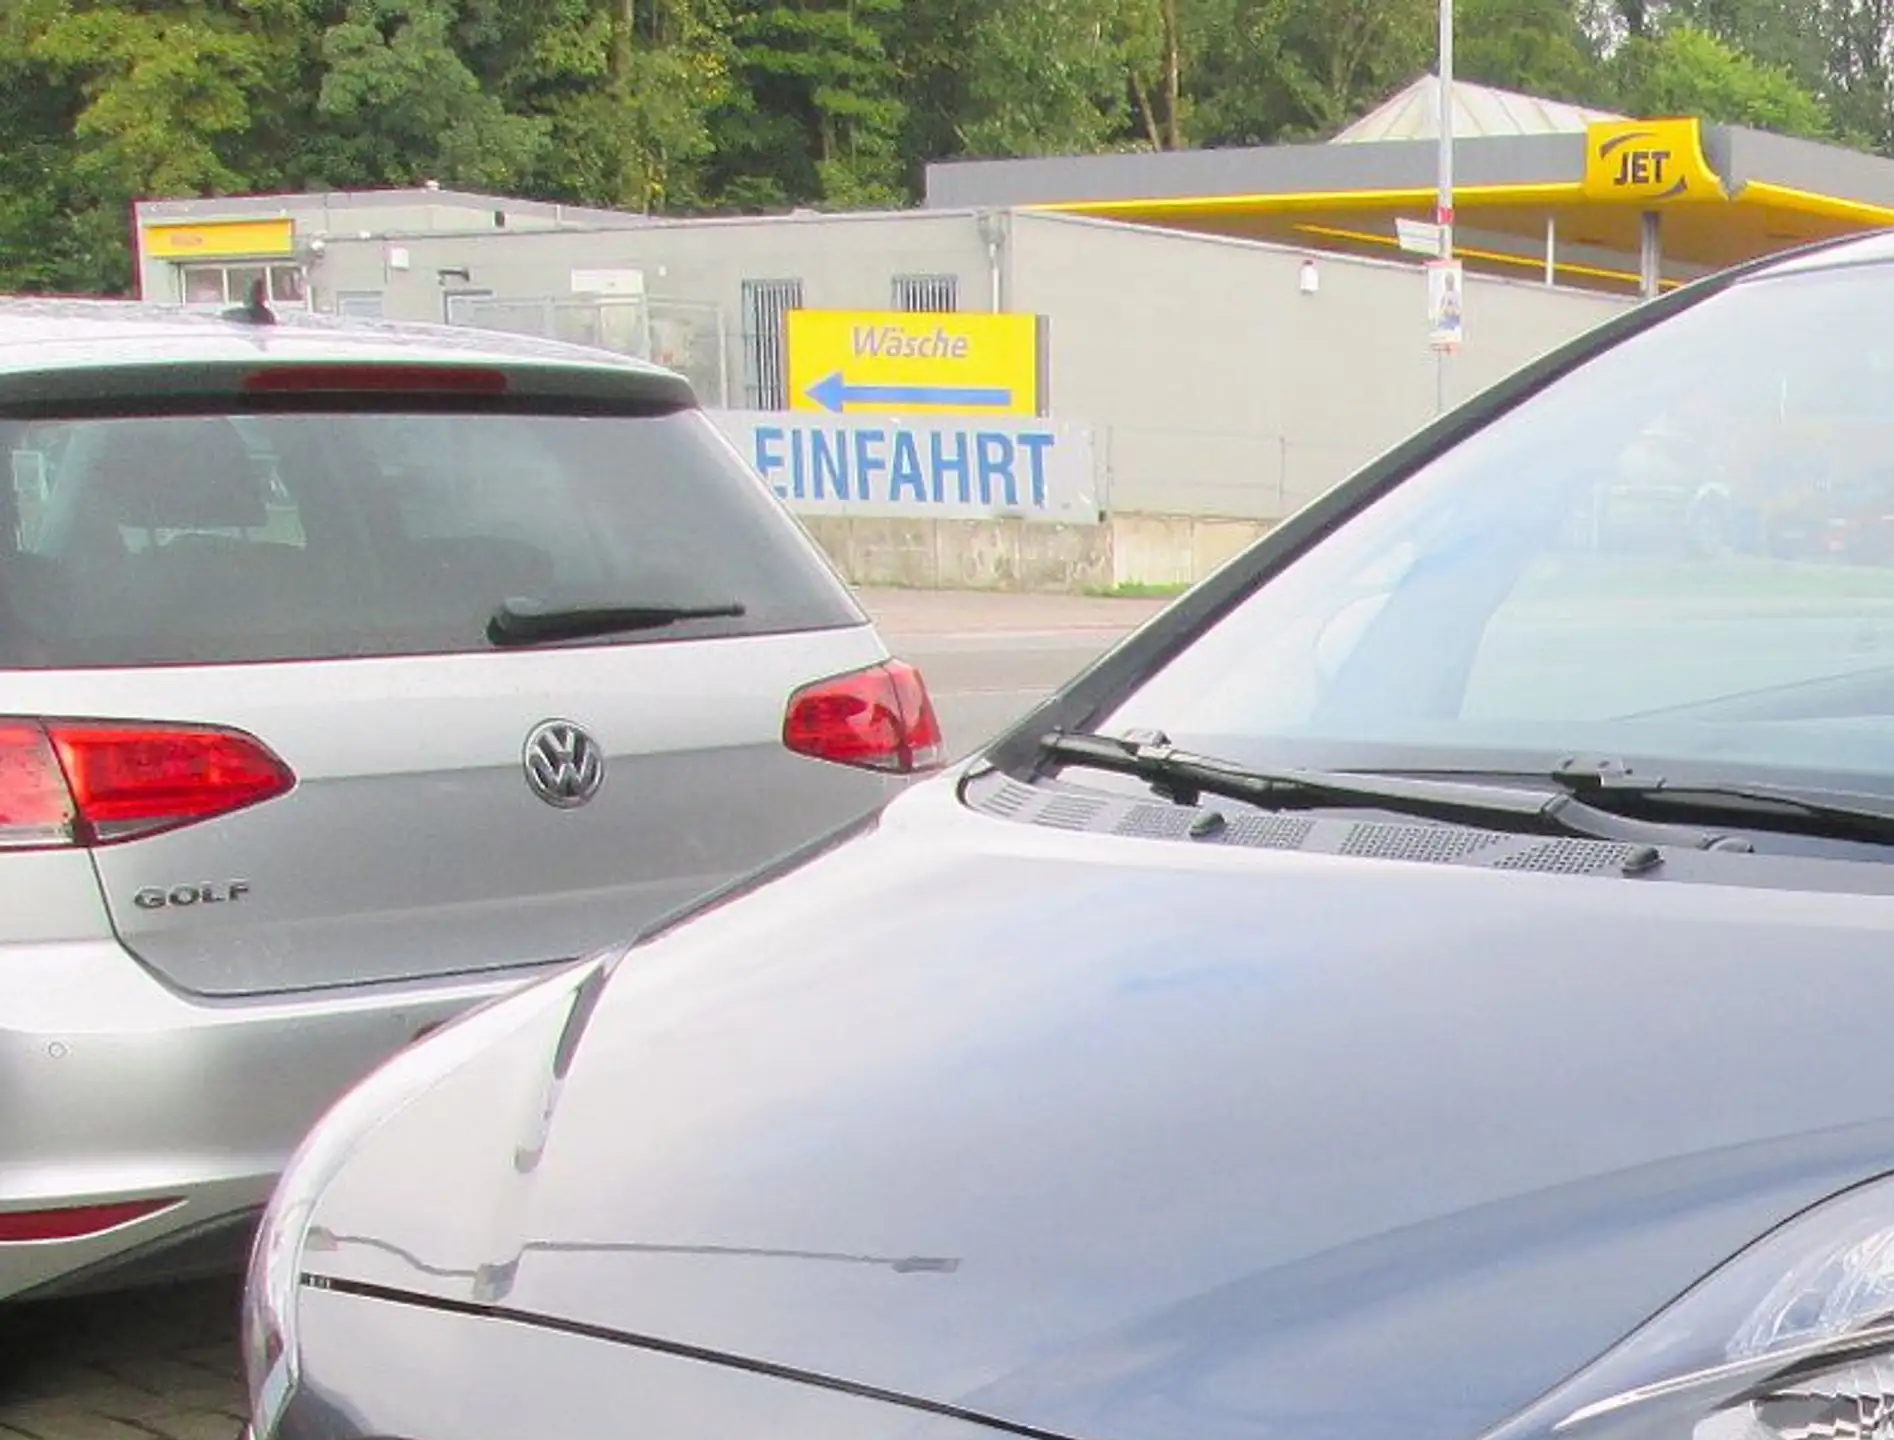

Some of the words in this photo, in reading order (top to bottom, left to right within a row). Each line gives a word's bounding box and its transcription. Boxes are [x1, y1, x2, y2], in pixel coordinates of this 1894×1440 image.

[1614, 151, 1671, 186] JET
[853, 325, 968, 358] Wäsche
[755, 426, 1055, 508] EINFAHRT
[134, 877, 249, 909] GOLF
